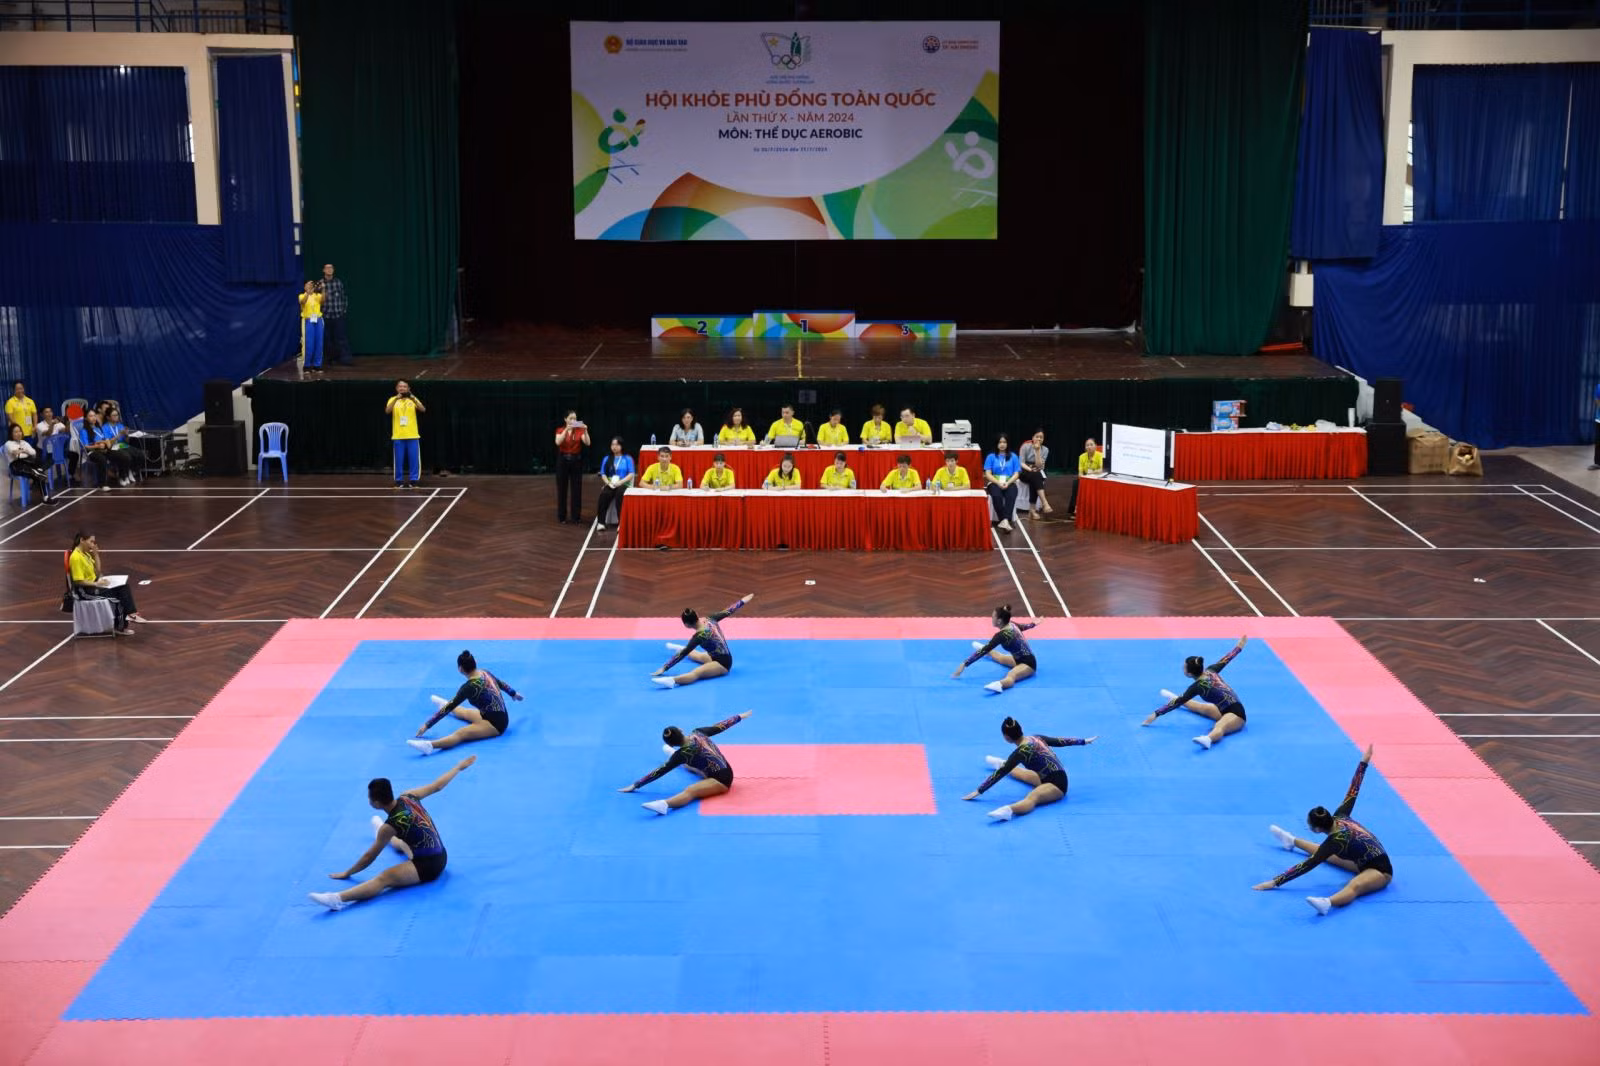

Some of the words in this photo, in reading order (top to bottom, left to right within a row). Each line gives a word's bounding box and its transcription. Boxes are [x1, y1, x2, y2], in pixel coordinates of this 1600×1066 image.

[646, 90, 677, 110] HỘI
[682, 90, 730, 107] KHỎE
[735, 90, 770, 107] PHÙ
[830, 89, 880, 106] TOÀN
[884, 88, 936, 108] QUỐC
[727, 111, 749, 123] LẦN
[752, 111, 778, 123] THỨ
[780, 113, 787, 123] X
[797, 111, 825, 123] NĂM
[828, 113, 854, 123] 2024
[719, 126, 752, 139] MÔN:
[755, 125, 779, 139] THỂ
[782, 128, 808, 140] DỤC
[810, 128, 863, 139] AEROBIC
[697, 320, 708, 334] 2
[800, 319, 808, 333] 1
[902, 325, 909, 336] 3
